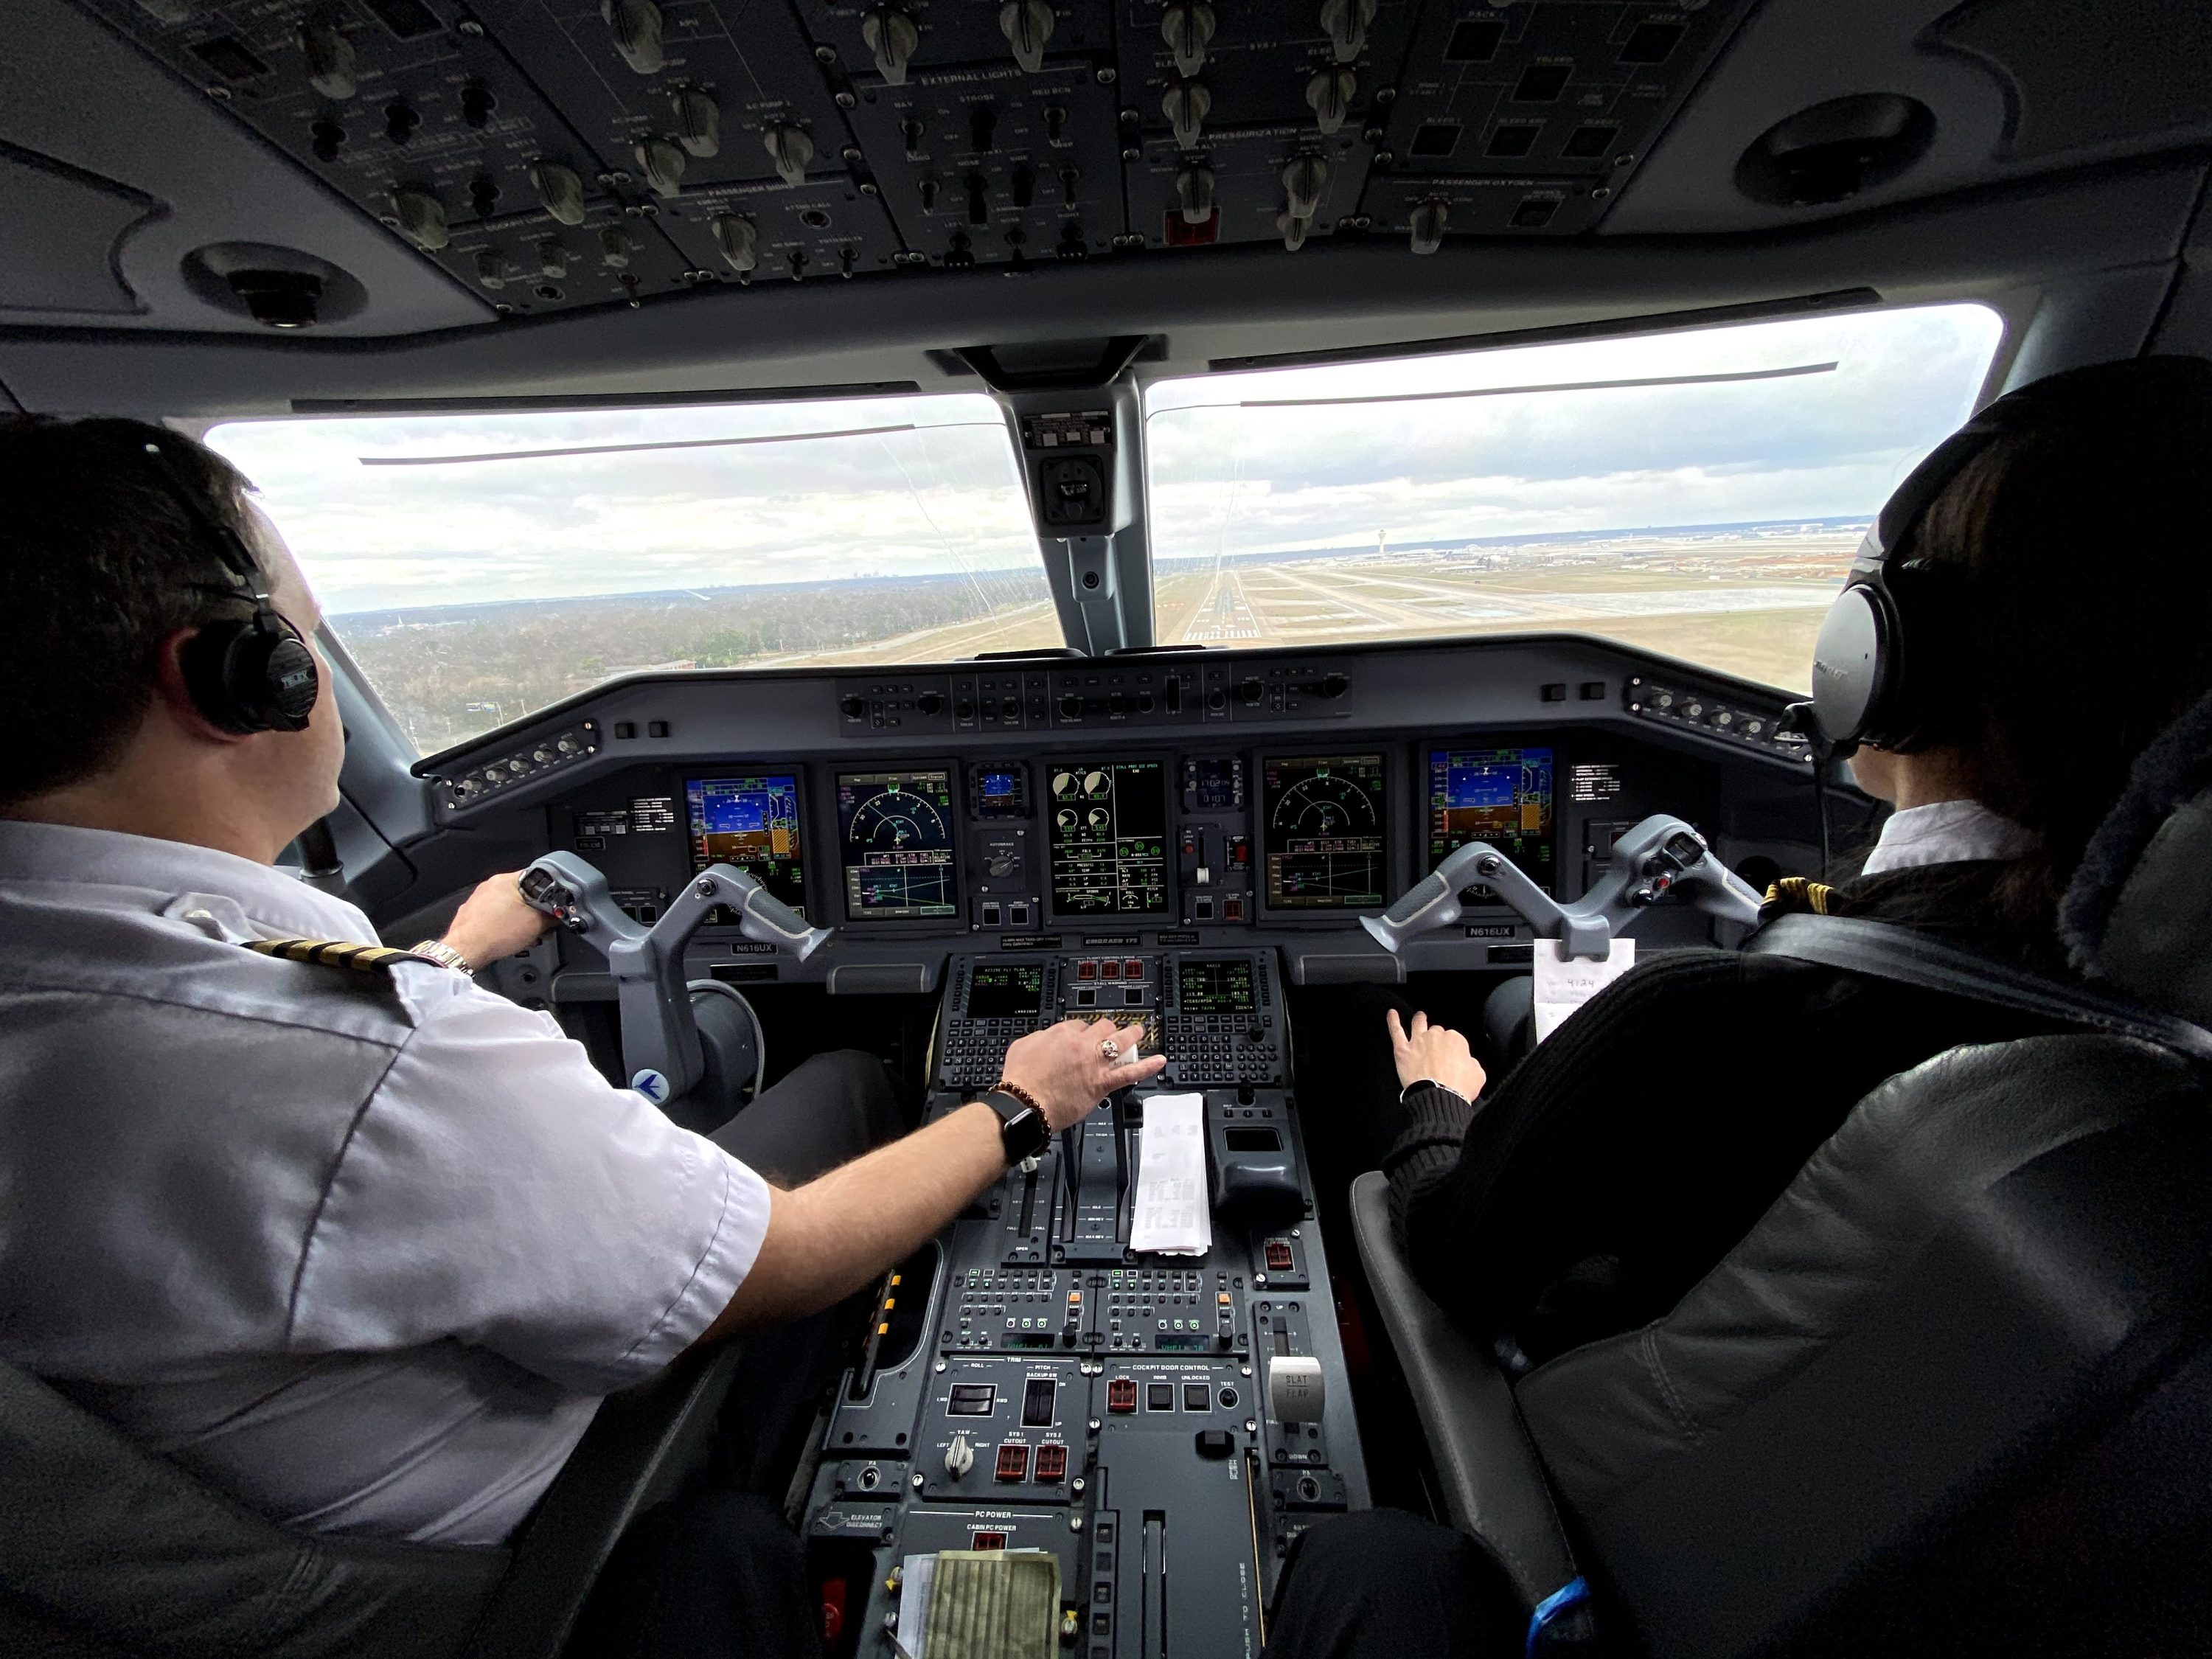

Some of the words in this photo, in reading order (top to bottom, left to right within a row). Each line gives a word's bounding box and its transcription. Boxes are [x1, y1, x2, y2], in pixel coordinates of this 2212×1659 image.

[921, 74, 980, 86] EXTERNAL
[960, 94, 995, 103] STROBE
[1208, 128, 1298, 141] PRESSURIZATION
[1470, 927, 1510, 936] N616UX
[737, 943, 773, 953] N616UX
[1285, 1375, 1308, 1384] SLAT
[1286, 1389, 1309, 1399] FLAP
[1242, 1605, 1248, 1621] TO
